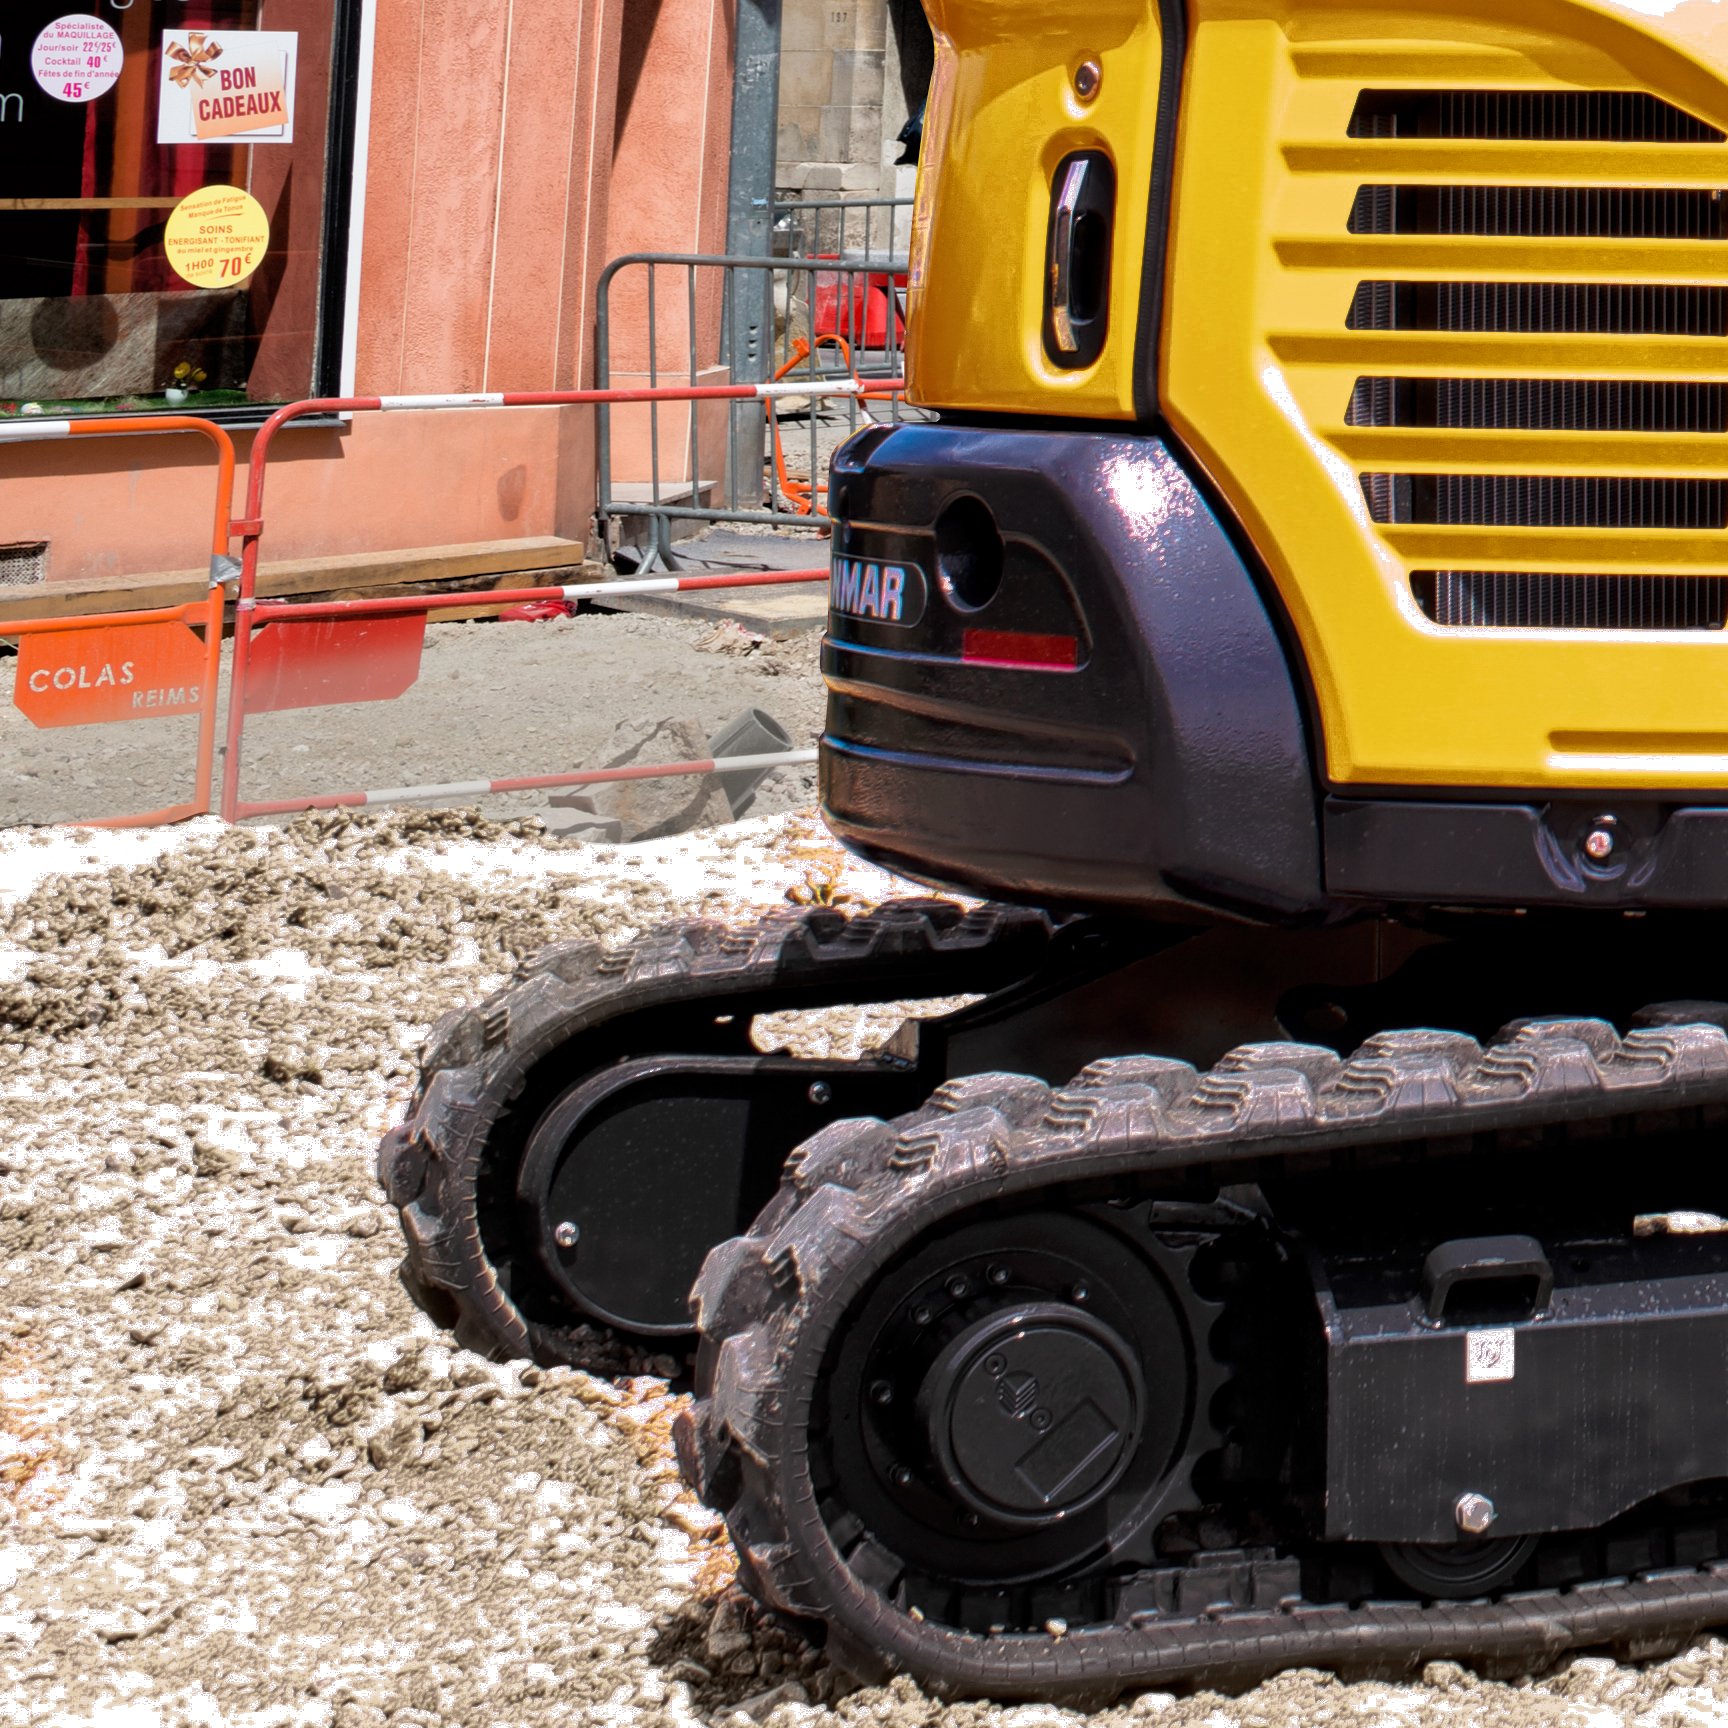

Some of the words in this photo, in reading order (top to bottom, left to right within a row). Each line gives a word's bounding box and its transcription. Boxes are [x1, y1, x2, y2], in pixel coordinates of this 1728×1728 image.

[55, 22, 104, 31] Spécialiste
[43, 31, 54, 39] du
[57, 31, 115, 39] MAQUILLAGE
[44, 56, 81, 66] Cocktail
[38, 69, 61, 78] Fêtes
[63, 70, 73, 78] de
[74, 69, 86, 78] fin
[220, 66, 257, 92] BON
[198, 90, 282, 122] CADEAUX
[199, 224, 233, 235] SOINS
[168, 237, 218, 246] ENERGISANT
[225, 235, 265, 245] TONIFIANT
[213, 245, 254, 255] gingembre
[185, 257, 215, 273] 1H00
[28, 660, 135, 693] COLAS
[131, 686, 200, 709] REIMS
